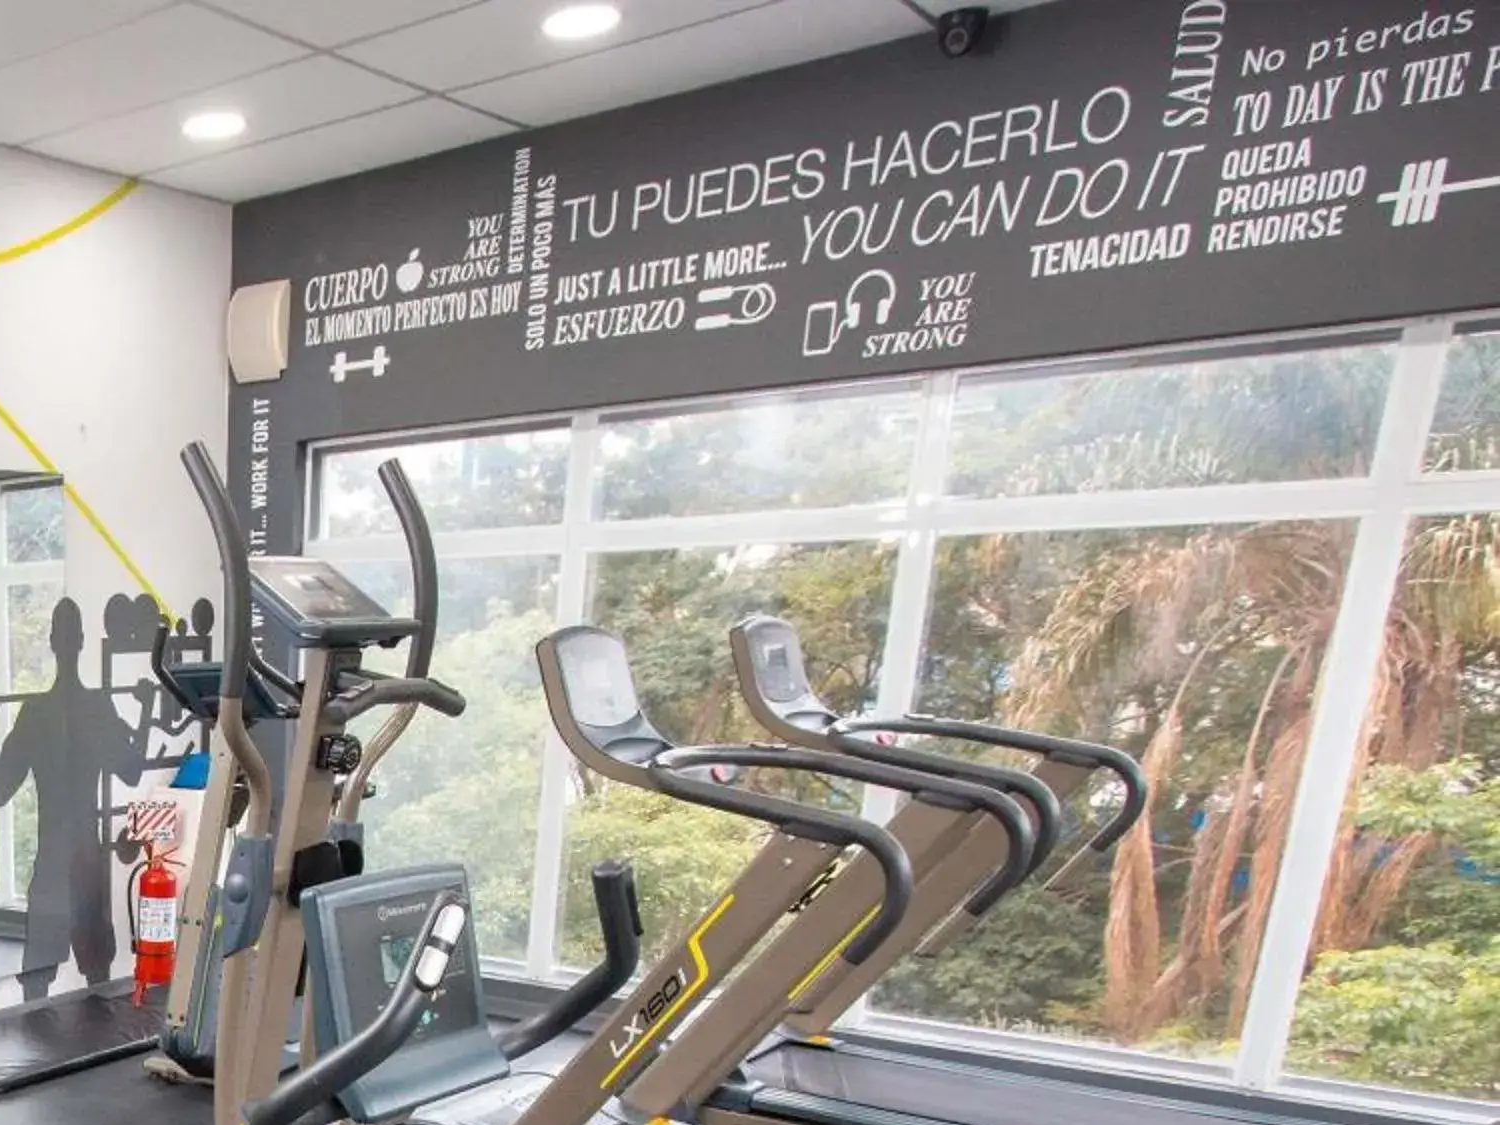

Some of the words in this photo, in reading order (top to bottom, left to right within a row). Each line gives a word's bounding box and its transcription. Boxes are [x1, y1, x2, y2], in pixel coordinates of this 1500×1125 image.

[1163, 0, 1228, 128] SALUD
[1241, 46, 1286, 77] No
[1306, 8, 1476, 71] pierdas
[1233, 91, 1271, 137] TO
[1282, 77, 1346, 128] DAY
[1352, 68, 1388, 116] IS
[1400, 51, 1470, 107] THE
[563, 192, 618, 243] TU
[631, 147, 826, 231] PUEDES
[842, 86, 1132, 188] HACERLO
[1221, 137, 1312, 181] QUEDA
[507, 146, 532, 274] DETERMINATION
[800, 197, 904, 267] YOU
[910, 178, 1030, 248] CAN
[1034, 159, 1130, 227] DO
[1137, 144, 1206, 211] IT
[1214, 165, 1368, 217] PROHIBIDO
[463, 236, 502, 260] ARE
[467, 213, 504, 239] YOU
[530, 221, 554, 271] POCO
[1029, 223, 1191, 278] TENACIDAD
[1207, 205, 1348, 254] RENDIRSE
[305, 263, 389, 313] CUERPO
[427, 259, 500, 289] STRONG
[529, 273, 550, 301] UN
[554, 273, 604, 305] JUST
[608, 277, 624, 299] A
[628, 259, 698, 295] LITTLE
[703, 242, 788, 286] MORE...
[918, 272, 975, 301] YOU
[305, 318, 322, 346] EL
[324, 305, 392, 343] MOMENTO
[394, 291, 466, 333] PERFECTO
[468, 287, 489, 322] ES
[490, 281, 523, 319] HOY
[525, 303, 547, 351] SOLO
[552, 297, 685, 346] ESFUERZO
[914, 298, 972, 327] ARE
[862, 325, 968, 359] STRONG
[253, 397, 272, 415] IT
[251, 418, 270, 454] FOR
[251, 457, 270, 510] WORK
